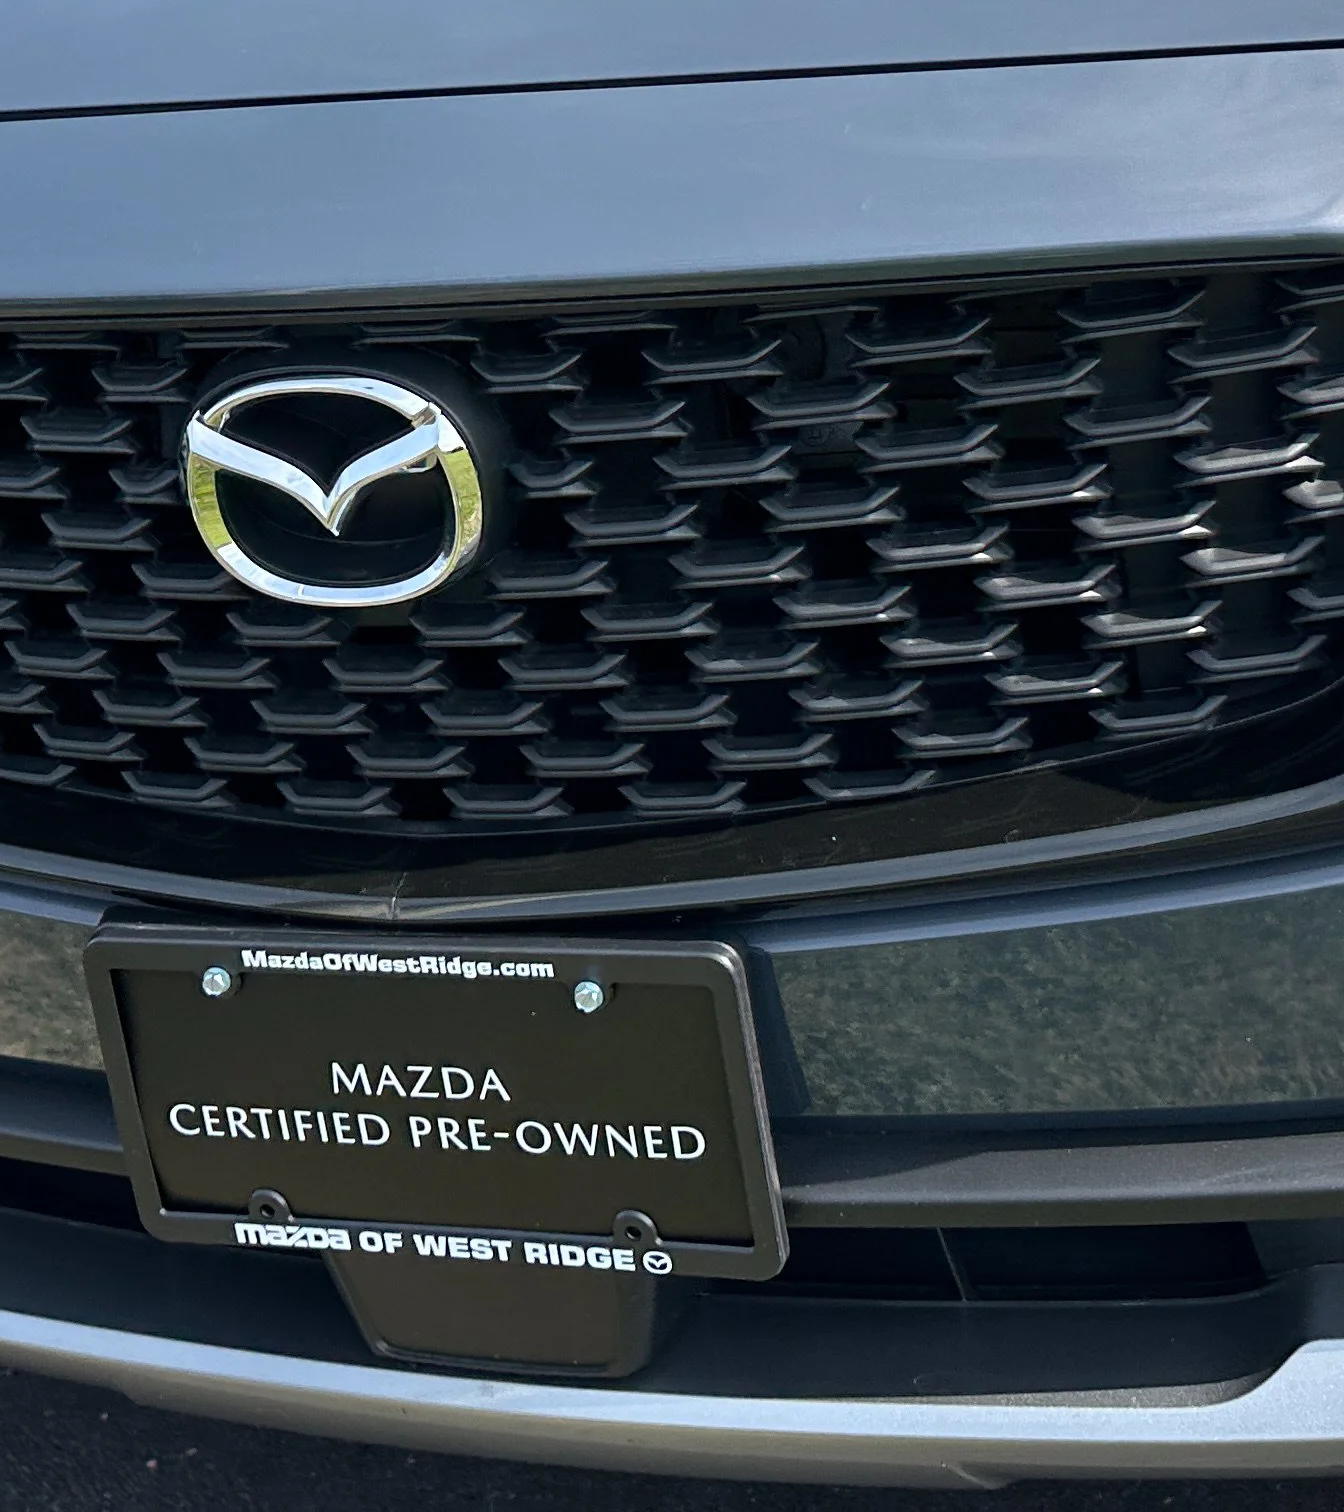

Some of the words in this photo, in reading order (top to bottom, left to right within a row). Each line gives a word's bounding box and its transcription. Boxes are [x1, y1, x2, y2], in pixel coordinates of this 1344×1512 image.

[241, 948, 555, 979] MazdaOfWestRidge.com
[330, 1062, 512, 1102] MAZDA
[169, 1103, 391, 1146] CERTIFIED
[410, 1115, 706, 1161] PRE-OWNED
[234, 1222, 352, 1251] mazda
[358, 1230, 403, 1254] OF
[412, 1233, 513, 1261] WEST
[523, 1241, 636, 1272] RIDGE
